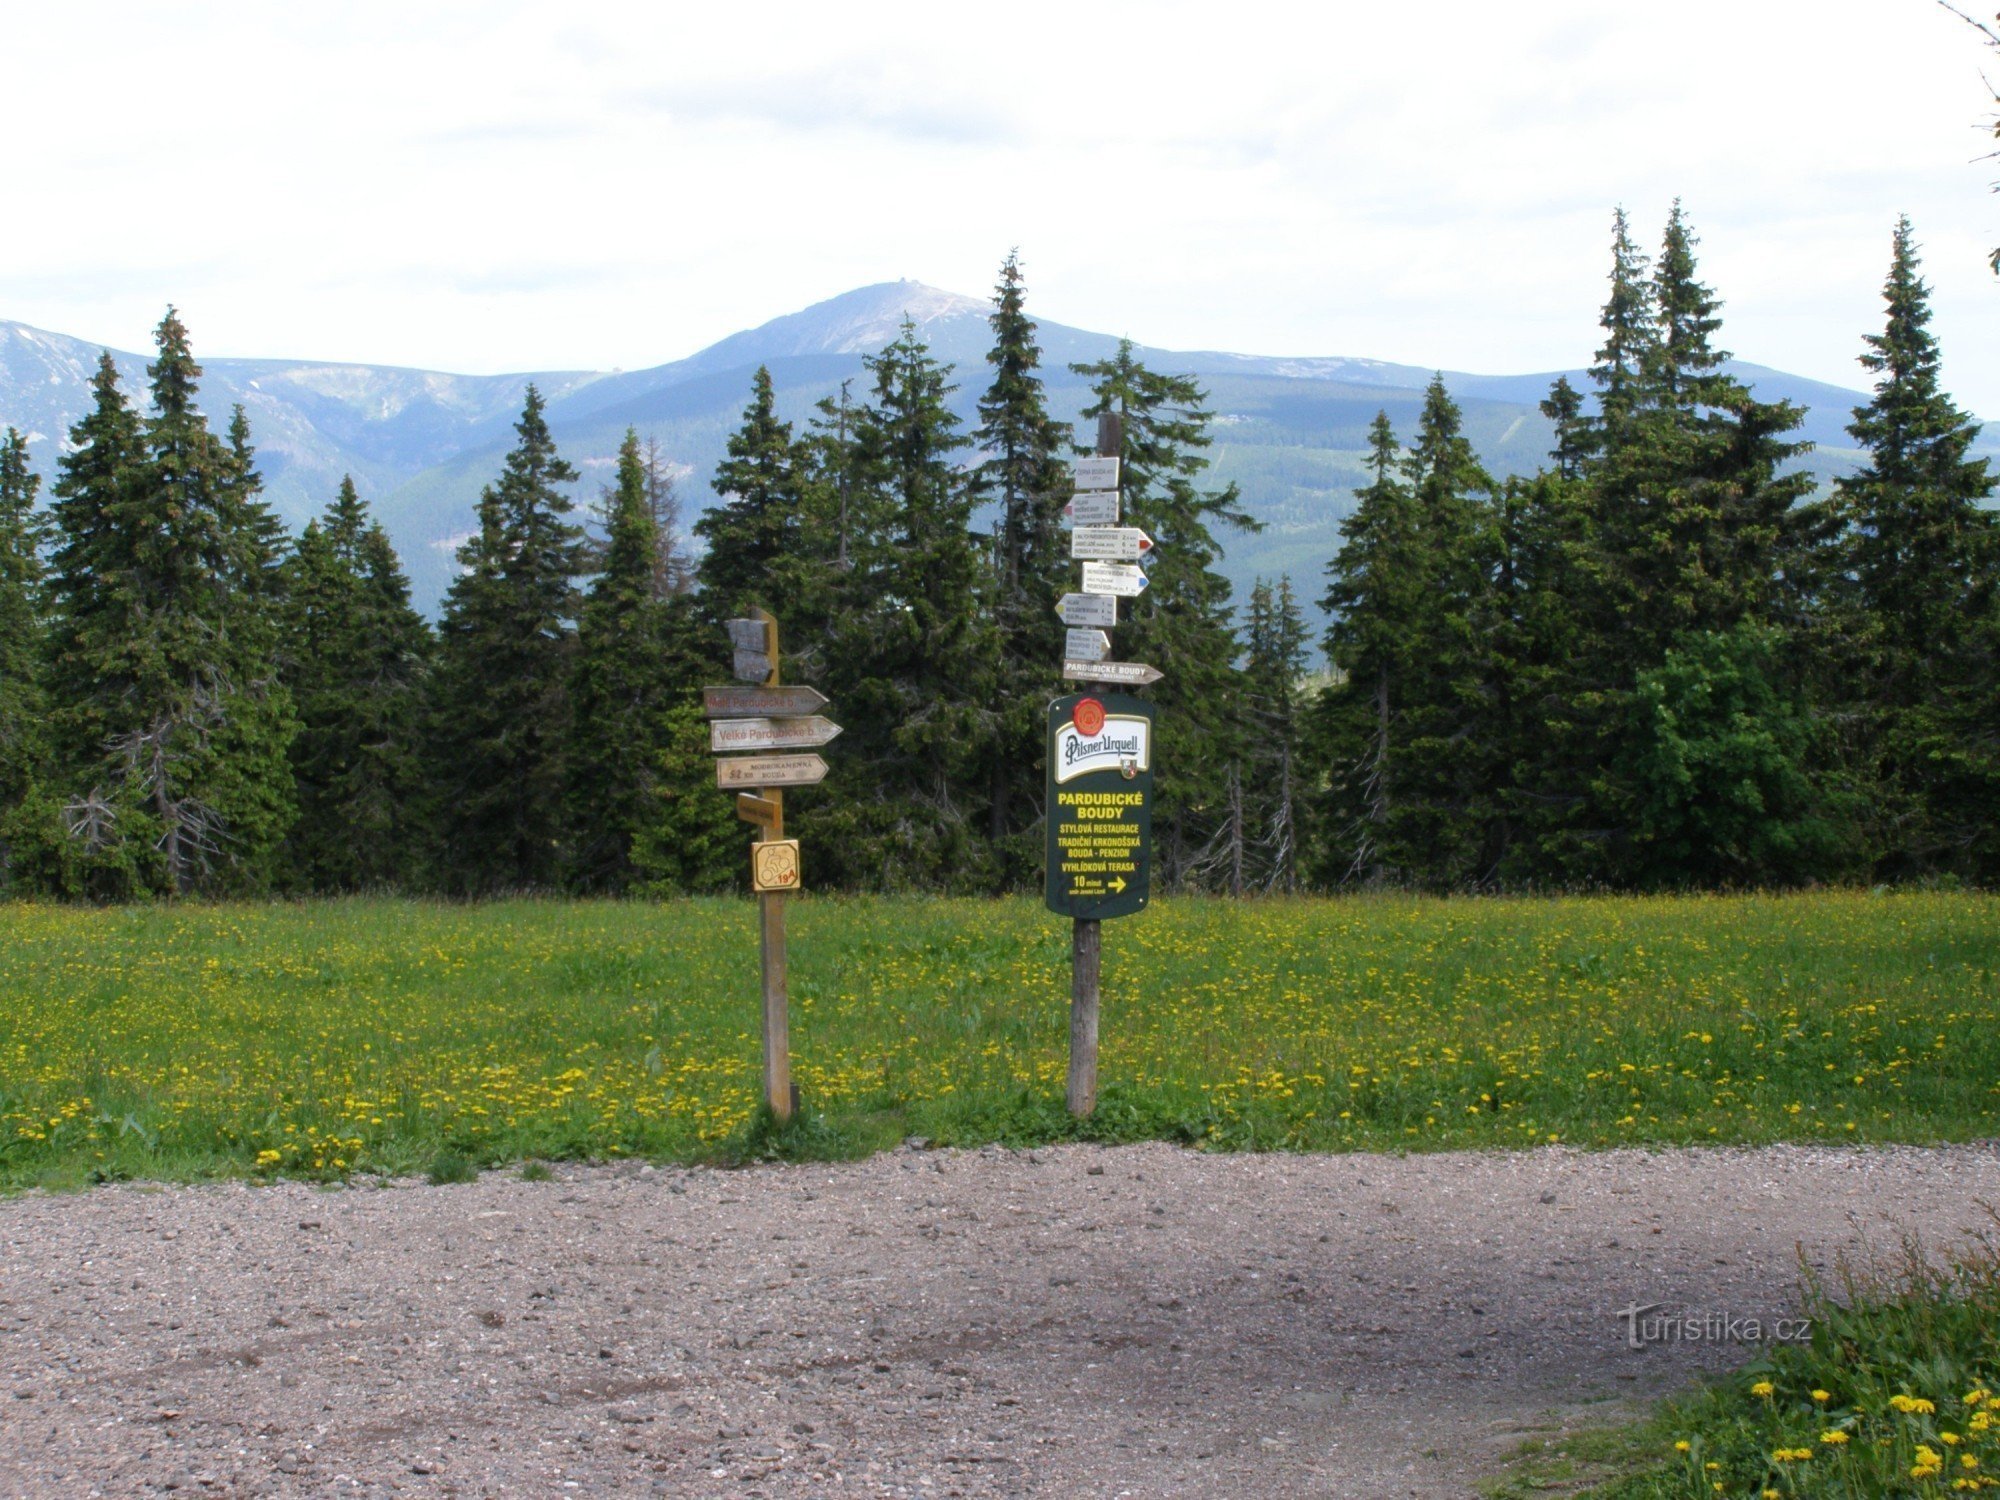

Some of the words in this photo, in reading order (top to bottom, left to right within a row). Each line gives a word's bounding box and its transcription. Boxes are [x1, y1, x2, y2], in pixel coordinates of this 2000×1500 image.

[1066, 662, 1117, 673] PARDUBICKÉ
[1119, 666, 1146, 676] BOUDY
[720, 730, 747, 741] Velké
[749, 727, 805, 740] Pardubické
[1065, 735, 1103, 766] Pilsner
[1102, 734, 1137, 757] Urquell
[751, 761, 812, 770] MODROKAMENNÁ
[1058, 791, 1143, 805] PARDUBICKÉ
[1077, 807, 1124, 819] BOUDY
[1060, 823, 1092, 833] STYLOVÁ
[1094, 824, 1139, 834] RESTAURACE
[1058, 836, 1092, 847] TRADIČNÍ
[1093, 836, 1140, 847] KRKONOŠSKÁ
[1068, 848, 1093, 858] BOUDA
[1099, 849, 1130, 858] PENZION
[1062, 861, 1107, 872] VYHLÍDKOVÁ
[1108, 862, 1135, 872] TERASA
[1074, 875, 1085, 887] 10
